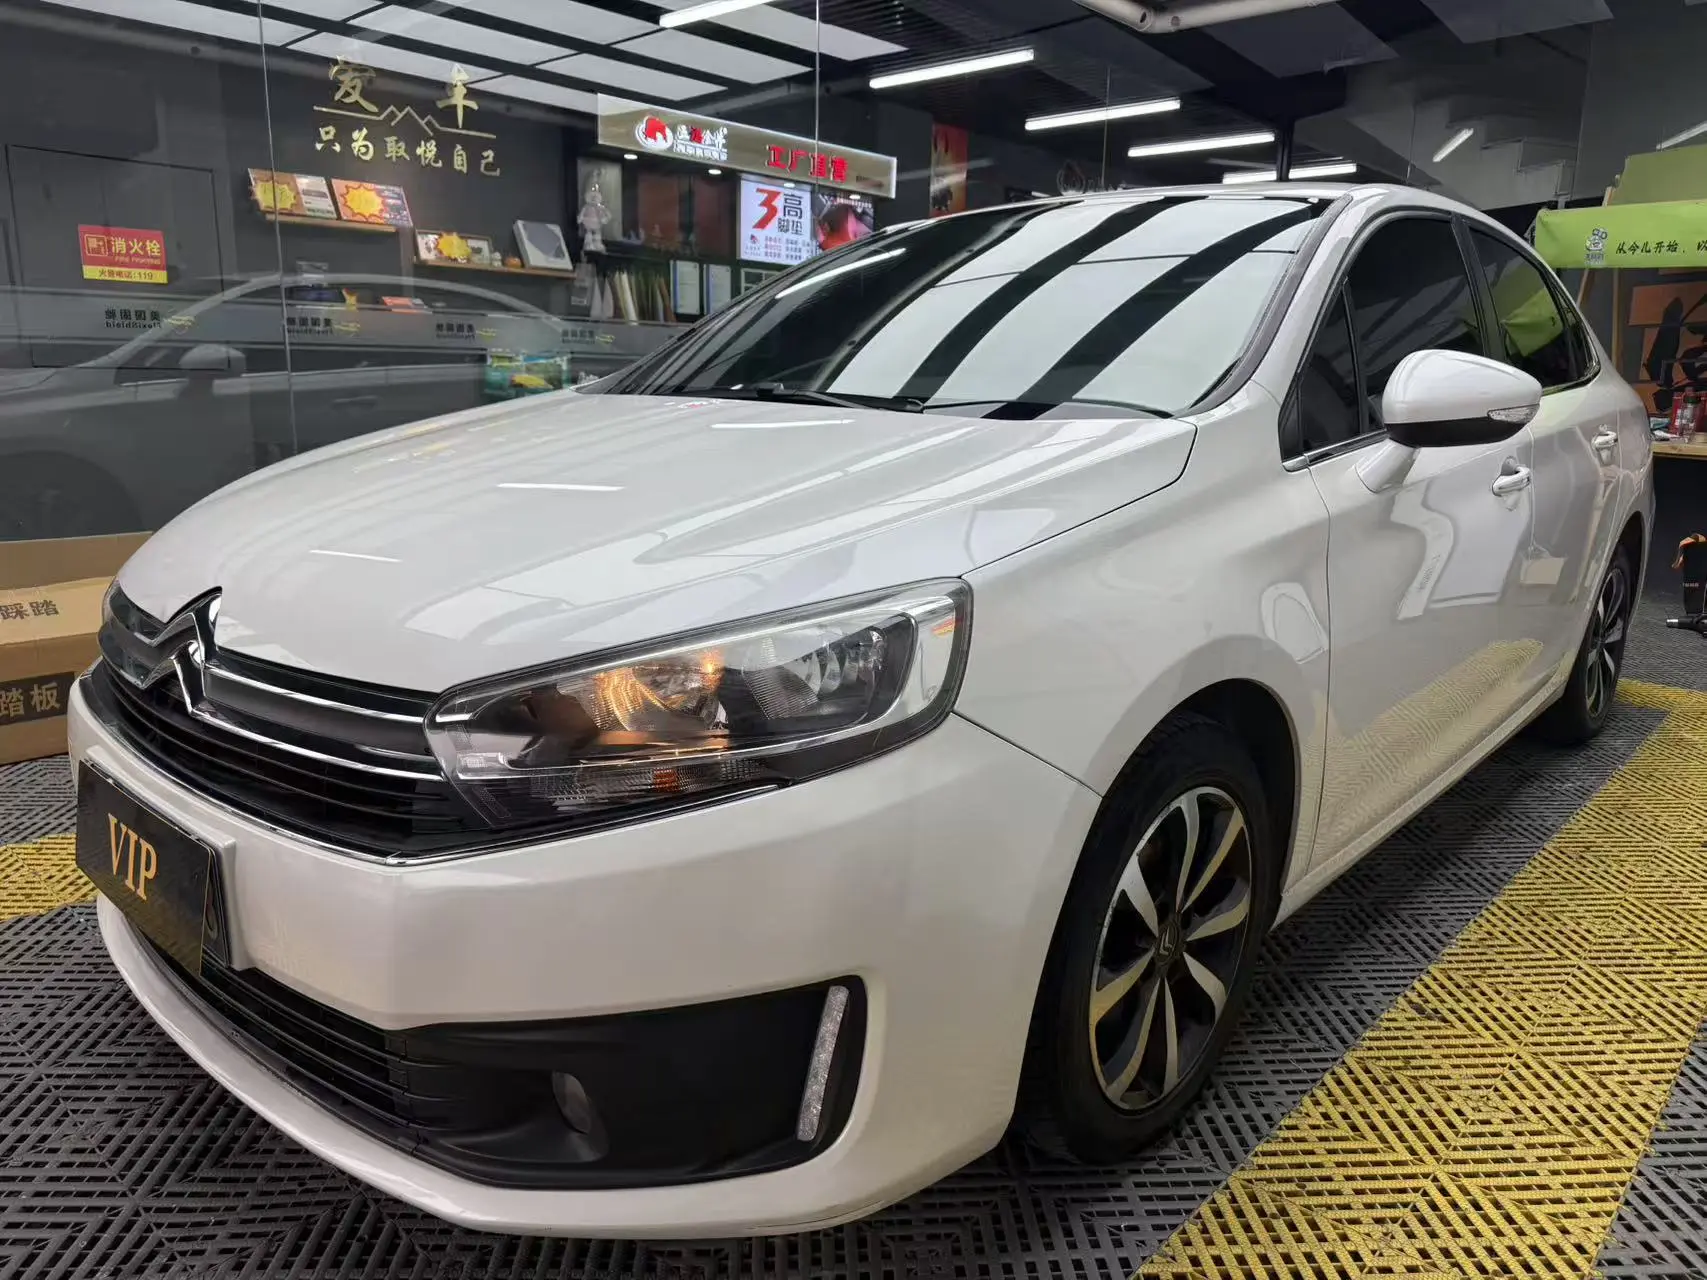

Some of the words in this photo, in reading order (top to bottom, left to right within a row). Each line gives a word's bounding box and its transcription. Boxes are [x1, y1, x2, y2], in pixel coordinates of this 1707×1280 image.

[315, 126, 500, 176] 只为取悦自己
[752, 187, 803, 230] 3高
[111, 237, 161, 256] 消火栓
[0, 599, 59, 620] 踩踏
[0, 682, 60, 717] 踏板
[108, 813, 158, 901] VIP
